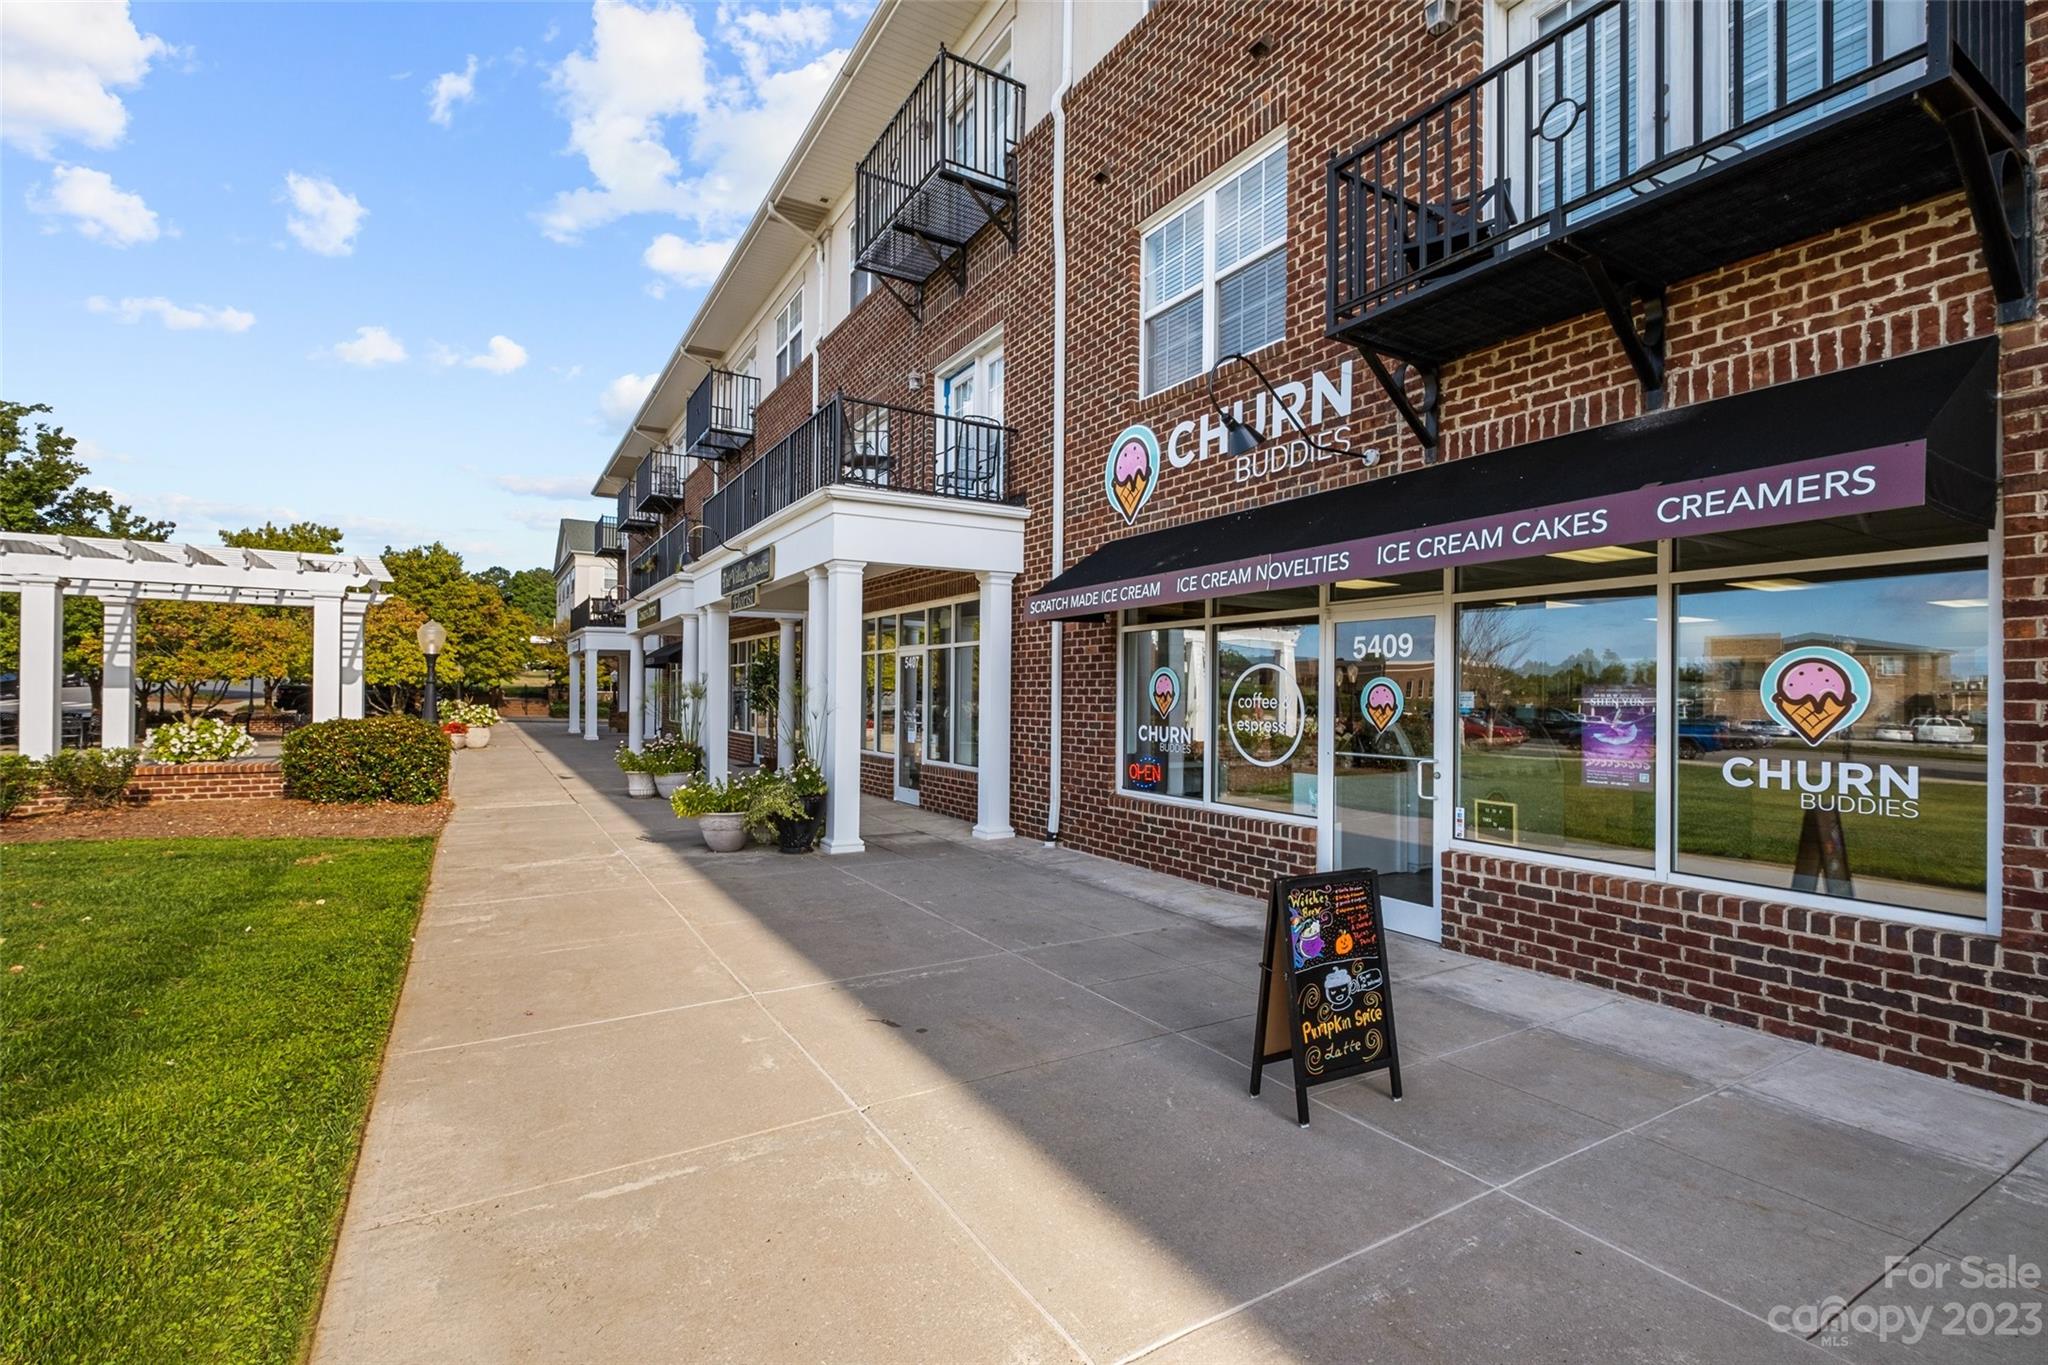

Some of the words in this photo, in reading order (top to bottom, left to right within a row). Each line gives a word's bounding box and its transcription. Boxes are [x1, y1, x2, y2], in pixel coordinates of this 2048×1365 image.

[1167, 360, 1353, 469] CHURN
[1235, 425, 1352, 483] BUDDIES
[1656, 464, 1877, 524] CREAMERS
[1376, 541, 1411, 565] ICE
[1416, 526, 1503, 558] CREAM
[1511, 508, 1608, 545] CAKES
[1176, 575, 1198, 593] ICE
[1200, 566, 1252, 590] CREAM
[1255, 551, 1350, 581] NOVELTIES
[1029, 596, 1069, 615] SCRATCH
[1070, 591, 1099, 609] MADE
[1100, 588, 1118, 604] ICE
[1120, 581, 1161, 601] CREAM
[1353, 633, 1413, 659] 5409
[904, 656, 920, 669] 5407
[1237, 691, 1278, 709] coffee
[1138, 725, 1192, 745] CHURN
[1236, 719, 1294, 737] espress
[1159, 743, 1192, 755] BUDDIES
[1129, 763, 1161, 781] OPEN
[1722, 756, 1920, 800] CHURN
[1800, 792, 1920, 820] BUDDIES
[1302, 1014, 1352, 1044] Pumpkin
[1355, 1007, 1383, 1027] Spice
[1324, 1039, 1362, 1060] Latte
